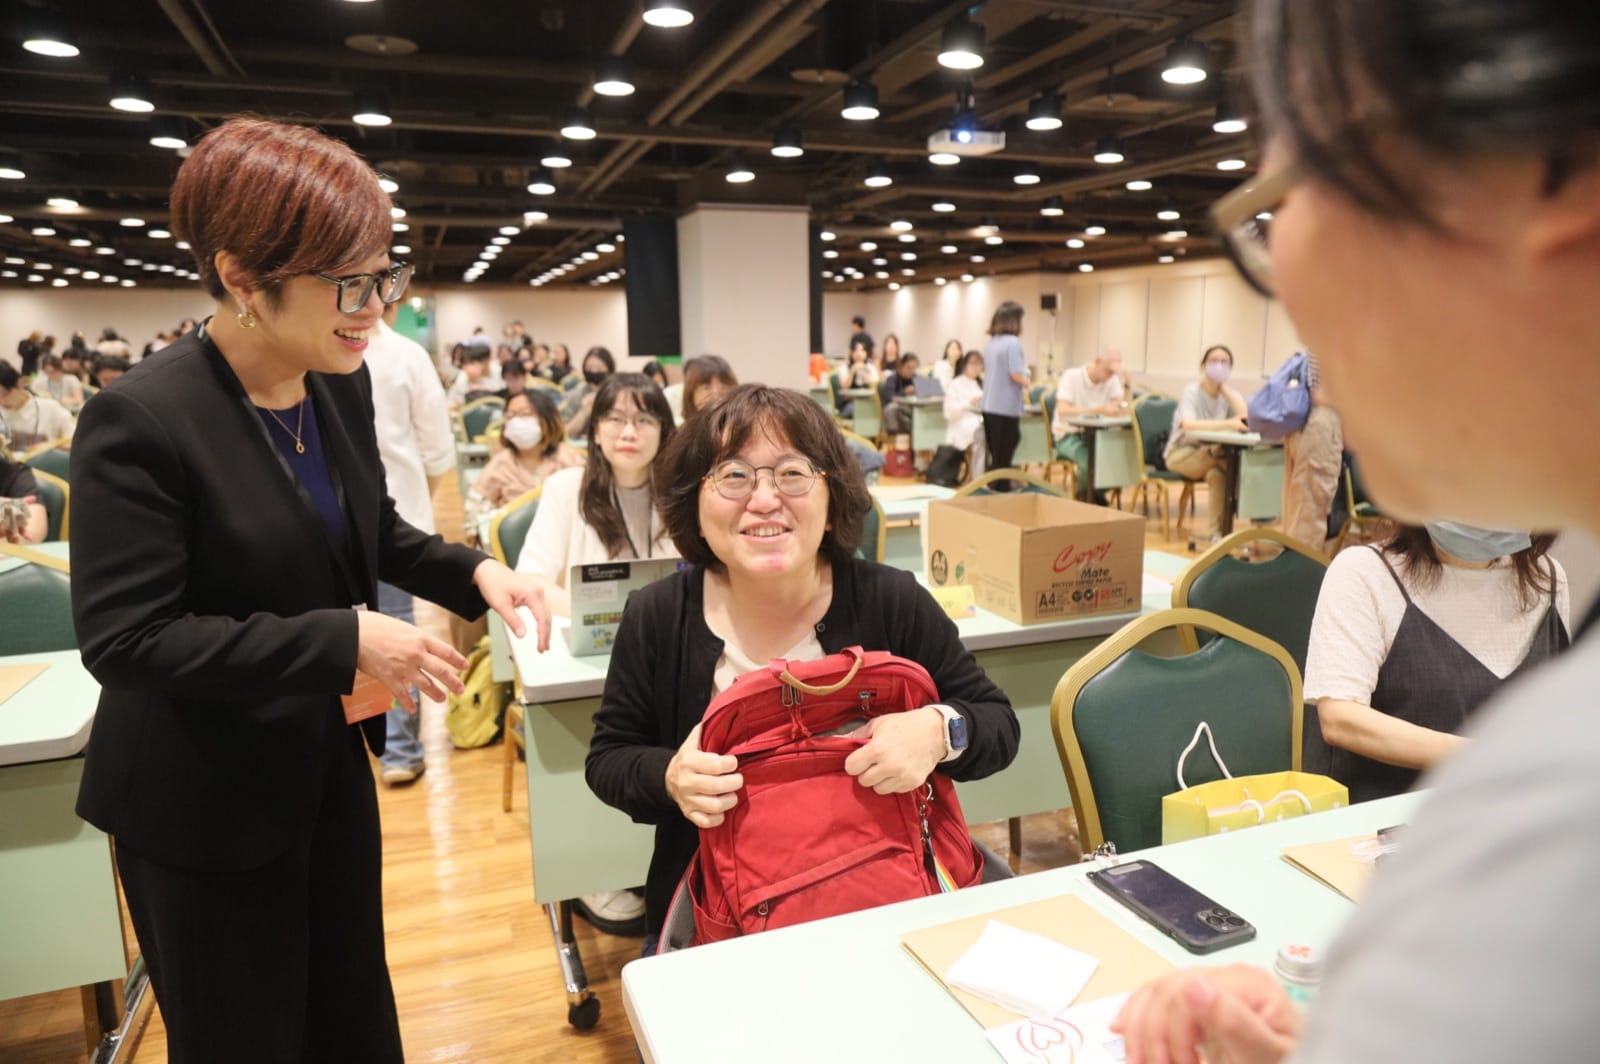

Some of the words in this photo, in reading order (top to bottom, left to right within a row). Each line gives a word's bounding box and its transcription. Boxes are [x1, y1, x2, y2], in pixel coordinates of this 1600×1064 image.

[1053, 541, 1112, 573] Copy
[1081, 567, 1110, 579] Mate
[1039, 592, 1056, 608] A4
